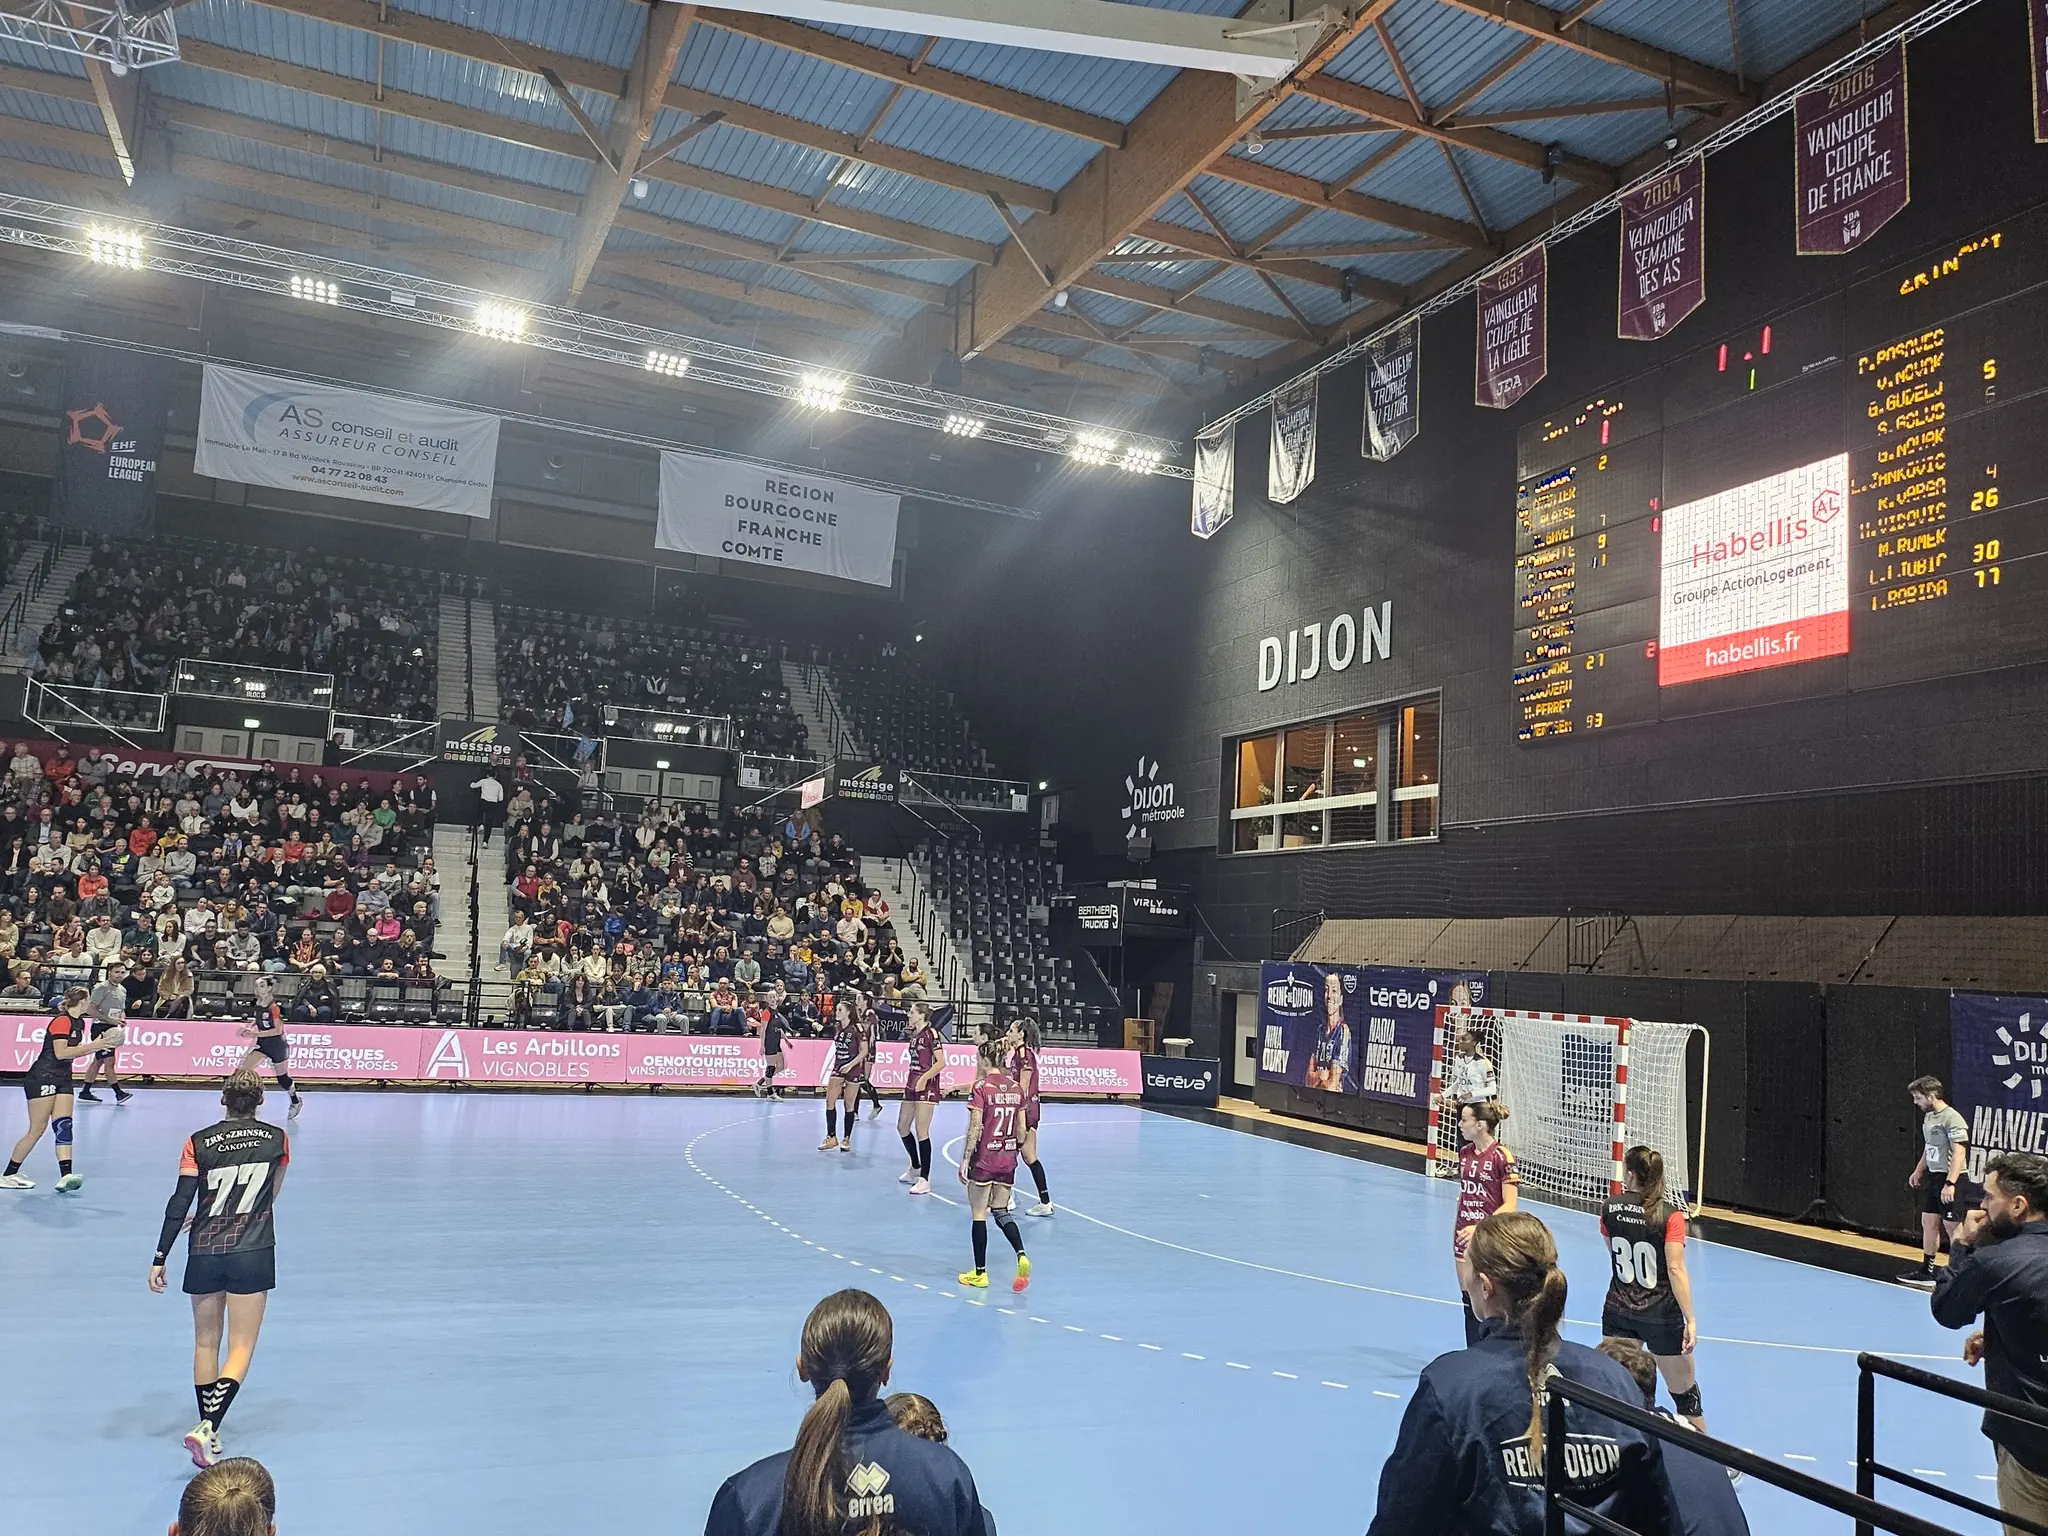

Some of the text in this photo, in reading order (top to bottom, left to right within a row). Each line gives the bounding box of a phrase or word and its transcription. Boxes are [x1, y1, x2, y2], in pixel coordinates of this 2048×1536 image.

[1828, 65, 1875, 109] 2006
[1807, 89, 1893, 157] VAINQUEUR
[1825, 128, 1876, 178] COUPE
[1643, 173, 1681, 211] 2004
[1808, 149, 1892, 215] DE FRANCE
[1628, 197, 1693, 251] VAINQUEUR
[1634, 228, 1686, 275] SEMAINE
[1639, 257, 1682, 299] DES AS
[1484, 284, 1538, 329] VAINQUEUR
[1486, 309, 1534, 351] COUPE DE
[1488, 334, 1532, 373] LA LIGUE
[1383, 395, 1409, 424] FUTUR
[279, 404, 460, 452] AS conseil et audit
[111, 440, 137, 450] EHF
[279, 427, 457, 466] ASSUREUR CONSEIL
[108, 467, 144, 482] LEAGUE
[109, 455, 157, 473] EUROPEAN
[311, 465, 388, 484] 04 77 22 08 43
[292, 474, 404, 496] www.asconseil-audit.com
[765, 479, 834, 504] REGION
[724, 494, 838, 527] BOURGOGNE
[1970, 487, 1999, 512] 26
[737, 519, 823, 546] FRANCHE
[1693, 516, 1808, 568] Habellis
[721, 540, 784, 562] COMTE
[1972, 539, 2001, 564] 30
[1673, 586, 1718, 605] Groupe
[1258, 600, 1392, 692] DIJON
[1705, 630, 1801, 667] habellis.fr
[445, 740, 511, 755] message
[839, 778, 894, 792] message
[1141, 805, 1185, 822] métropole
[1132, 897, 1164, 908] VIRLY
[1267, 985, 1289, 1007] REINE
[1293, 986, 1313, 1008] DIJON
[16, 1023, 45, 1043] Le
[880, 1019, 908, 1032] SPAC
[1369, 1017, 1396, 1045] NADIA
[285, 1033, 332, 1046] SITES
[482, 1037, 621, 1057] Les Arbillons
[689, 1044, 741, 1056] VISITES
[192, 1056, 225, 1067] VINS
[287, 1060, 340, 1069] BLANCS
[643, 1055, 767, 1069] OENOTOURISTIQU
[875, 1051, 893, 1064] es
[1038, 1054, 1080, 1066] VISITES
[1366, 1042, 1407, 1071] MIELKE
[2014, 1041, 2048, 1065] DIJ
[482, 1060, 590, 1078] VIGNOBLES
[629, 1066, 656, 1076] VINS
[658, 1067, 704, 1077] ROUGES
[707, 1068, 750, 1078] BLANCS
[752, 1069, 760, 1077] &
[1038, 1066, 1118, 1079] OURISTIQUES
[1052, 1076, 1089, 1086] BLANCS
[1364, 1066, 1416, 1098] OFFENDAL
[994, 1107, 1017, 1137] 27
[1971, 1105, 2048, 1154] MANUE
[1468, 1160, 1479, 1178] 5
[207, 1162, 270, 1218] 77
[1460, 1180, 1488, 1198] JDA
[1611, 1236, 1658, 1289] 30
[1502, 1443, 1620, 1480] REIN DIJON
[848, 1494, 896, 1518] errea
